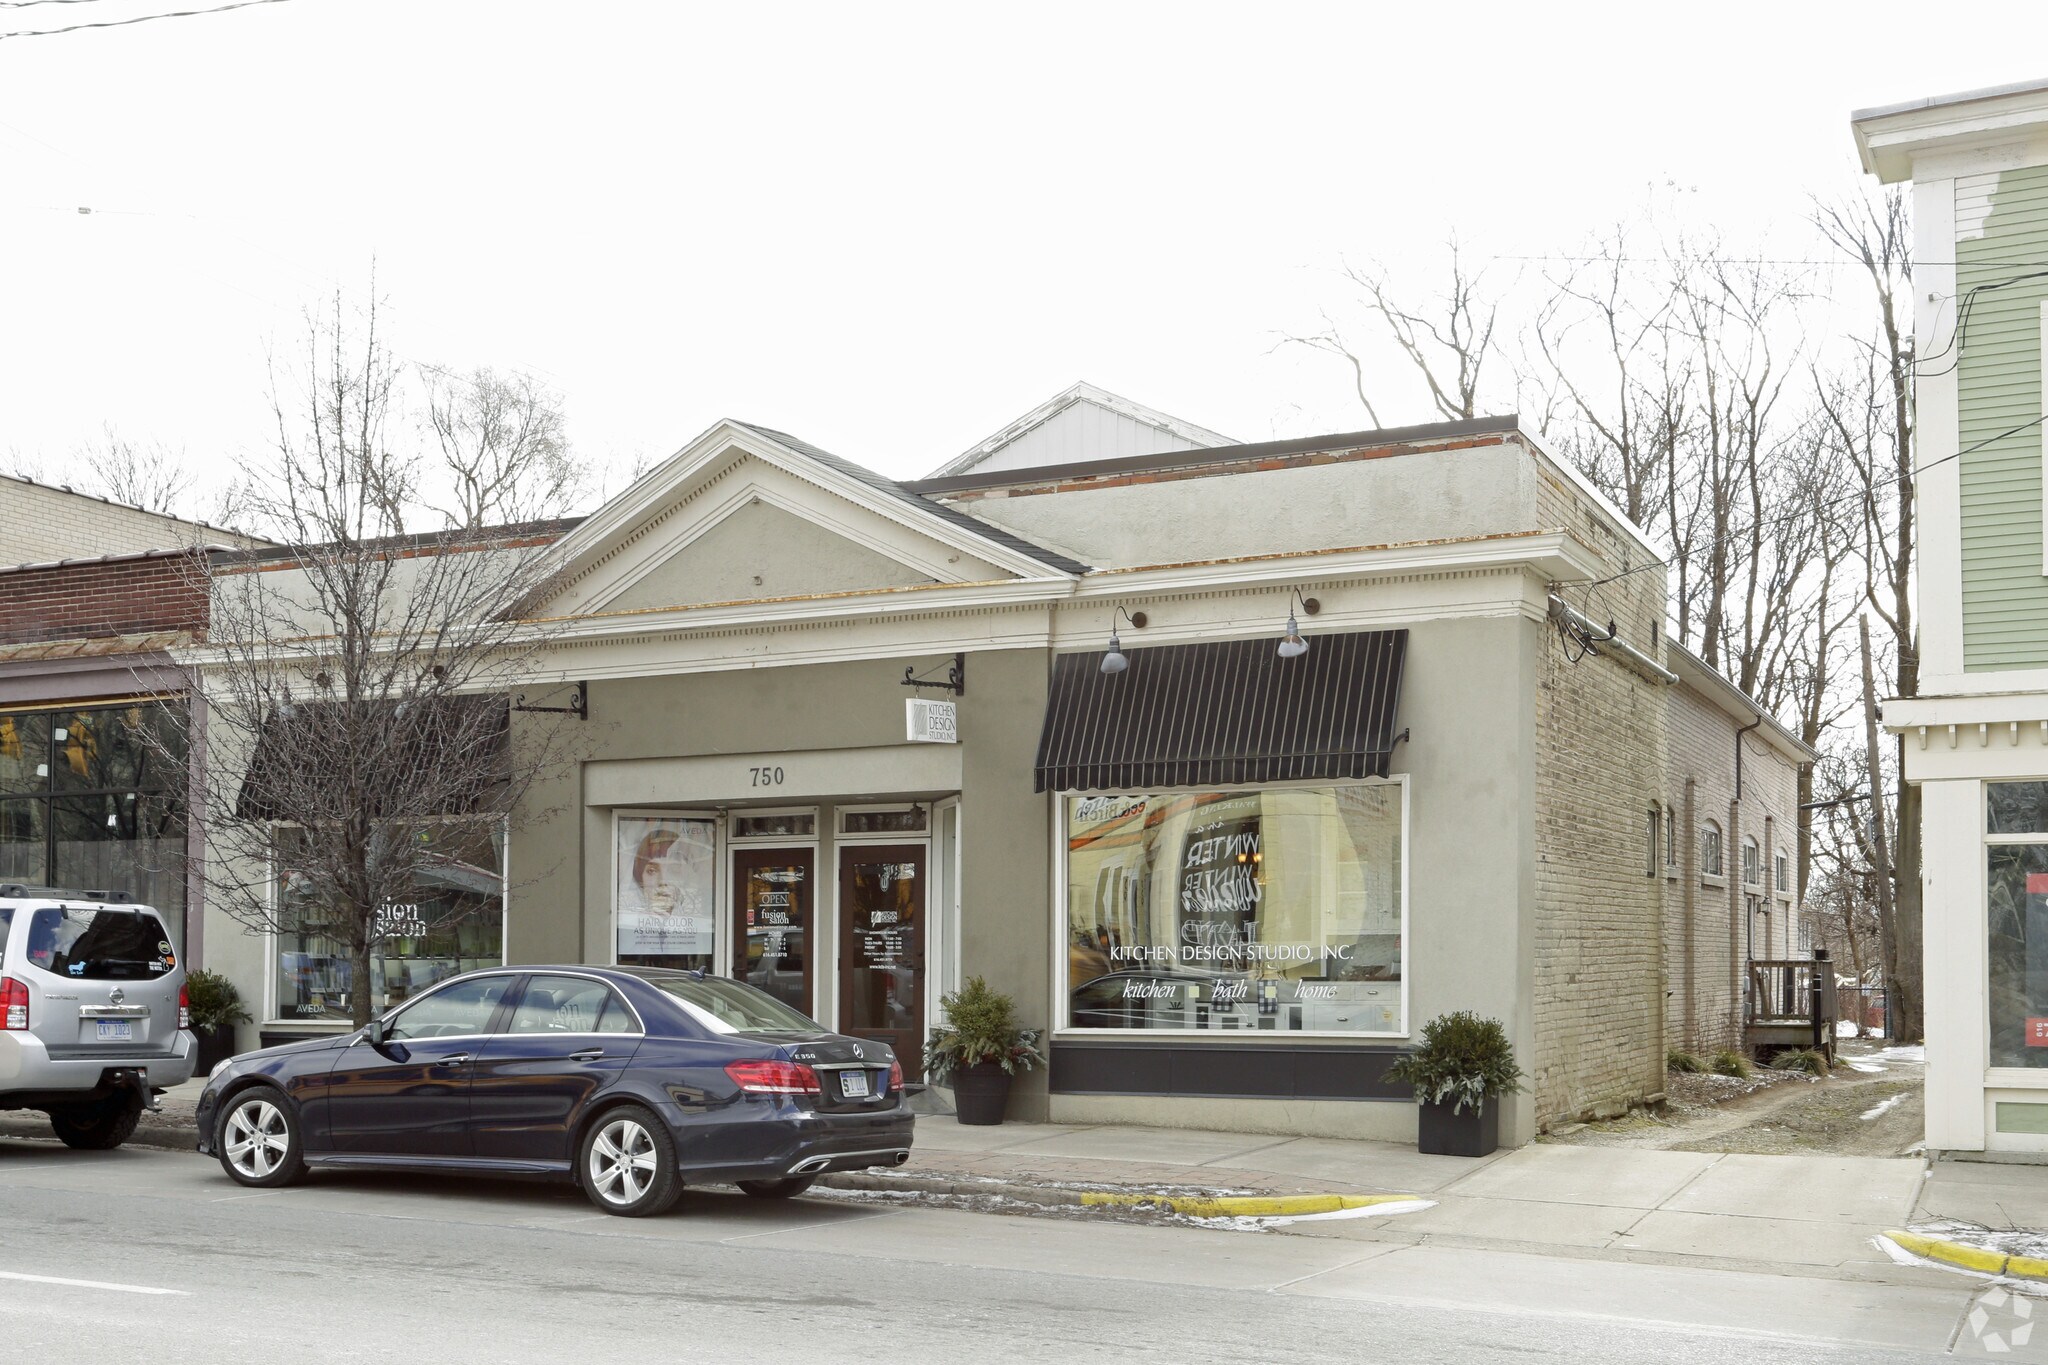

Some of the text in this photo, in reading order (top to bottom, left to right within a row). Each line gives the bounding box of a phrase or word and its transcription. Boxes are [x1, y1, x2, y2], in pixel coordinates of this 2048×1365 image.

[929, 704, 955, 717] KITCHEN
[929, 716, 956, 731] DESIGN
[750, 766, 784, 787] 750
[681, 827, 708, 835] AVEDA
[761, 894, 788, 904] OPEN
[376, 896, 419, 920] sion
[761, 909, 786, 919] fusion
[638, 917, 694, 927] HAIR COLOR
[769, 916, 789, 924] salon
[633, 927, 644, 935] AS
[645, 927, 671, 936] UNIQUE
[1110, 944, 1354, 963] KITCHEN DESIGN STUDIO, INC.
[1122, 979, 1337, 998] kitchen bath home
[296, 1004, 326, 1013] AVEDA
[98, 1024, 131, 1036] CKY 1023
